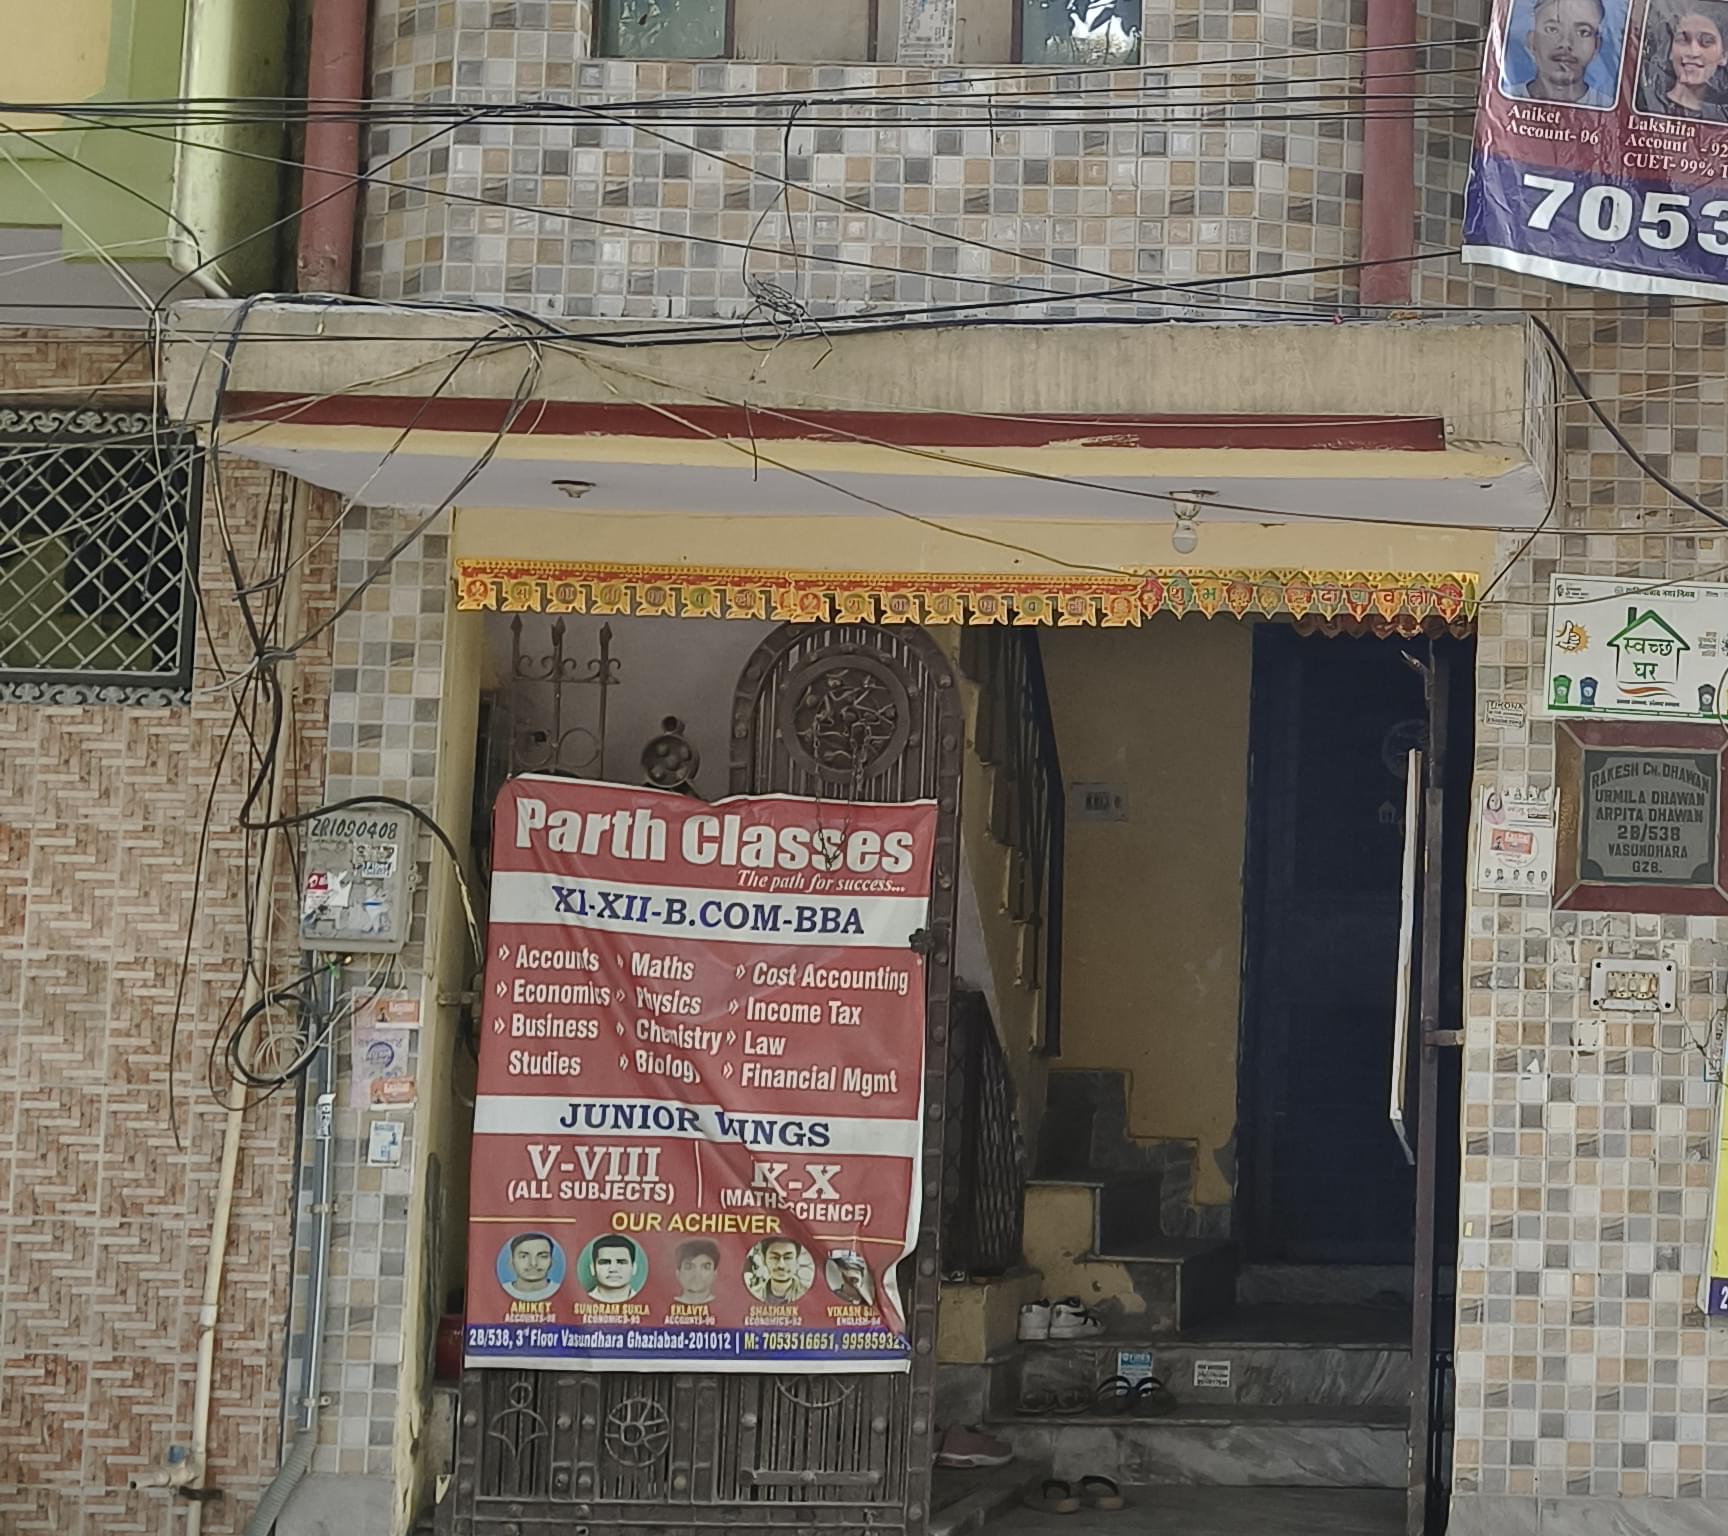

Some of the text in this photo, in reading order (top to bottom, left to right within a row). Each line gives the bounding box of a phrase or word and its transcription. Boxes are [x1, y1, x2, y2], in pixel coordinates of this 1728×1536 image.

[1507, 104, 1561, 124] Aniket
[1627, 116, 1696, 138] Lakshita
[1625, 133, 1690, 153] Account
[1622, 636, 1675, 657] स्वच्छ
[1632, 661, 1660, 681] घर
[1591, 761, 1710, 794] RAKESH DHAWAN
[1595, 789, 1705, 806] URMILA DHAWAN
[310, 816, 398, 840] ZR1090408
[1595, 806, 1704, 824] ARPITA DHAWAN
[514, 796, 915, 875] Parth Classes
[1617, 823, 1681, 843] 2B/538
[1608, 843, 1689, 859] VASUNDHARA
[737, 869, 769, 887] The
[772, 871, 805, 894] path
[804, 873, 833, 894] for
[515, 943, 600, 972] Accounts
[631, 951, 695, 982] Maths
[513, 978, 611, 1006] Economics
[752, 962, 910, 996] Cost Accounting
[636, 986, 702, 1016] Physics
[746, 996, 863, 1026] Income Tax
[511, 1012, 599, 1040] Business
[744, 1030, 787, 1057] Law
[508, 1049, 582, 1076] Studies
[741, 1062, 899, 1098] Financial Mgmt
[559, 1102, 702, 1133] JUNIOR
[526, 1144, 662, 1183] V-VIII
[507, 1179, 675, 1205] (ALL SUBJECTS)
[611, 1211, 782, 1235] OUR ACHIEVER
[510, 1301, 552, 1314] ANIKET
[468, 1328, 513, 1350] 2B/538,
[530, 1329, 559, 1348] Floor
[561, 1330, 624, 1350] Vasundhara
[627, 1330, 732, 1351] Ghaziabad-201012
[743, 1332, 759, 1350] M:
[762, 1332, 840, 1352] 7053516651,
